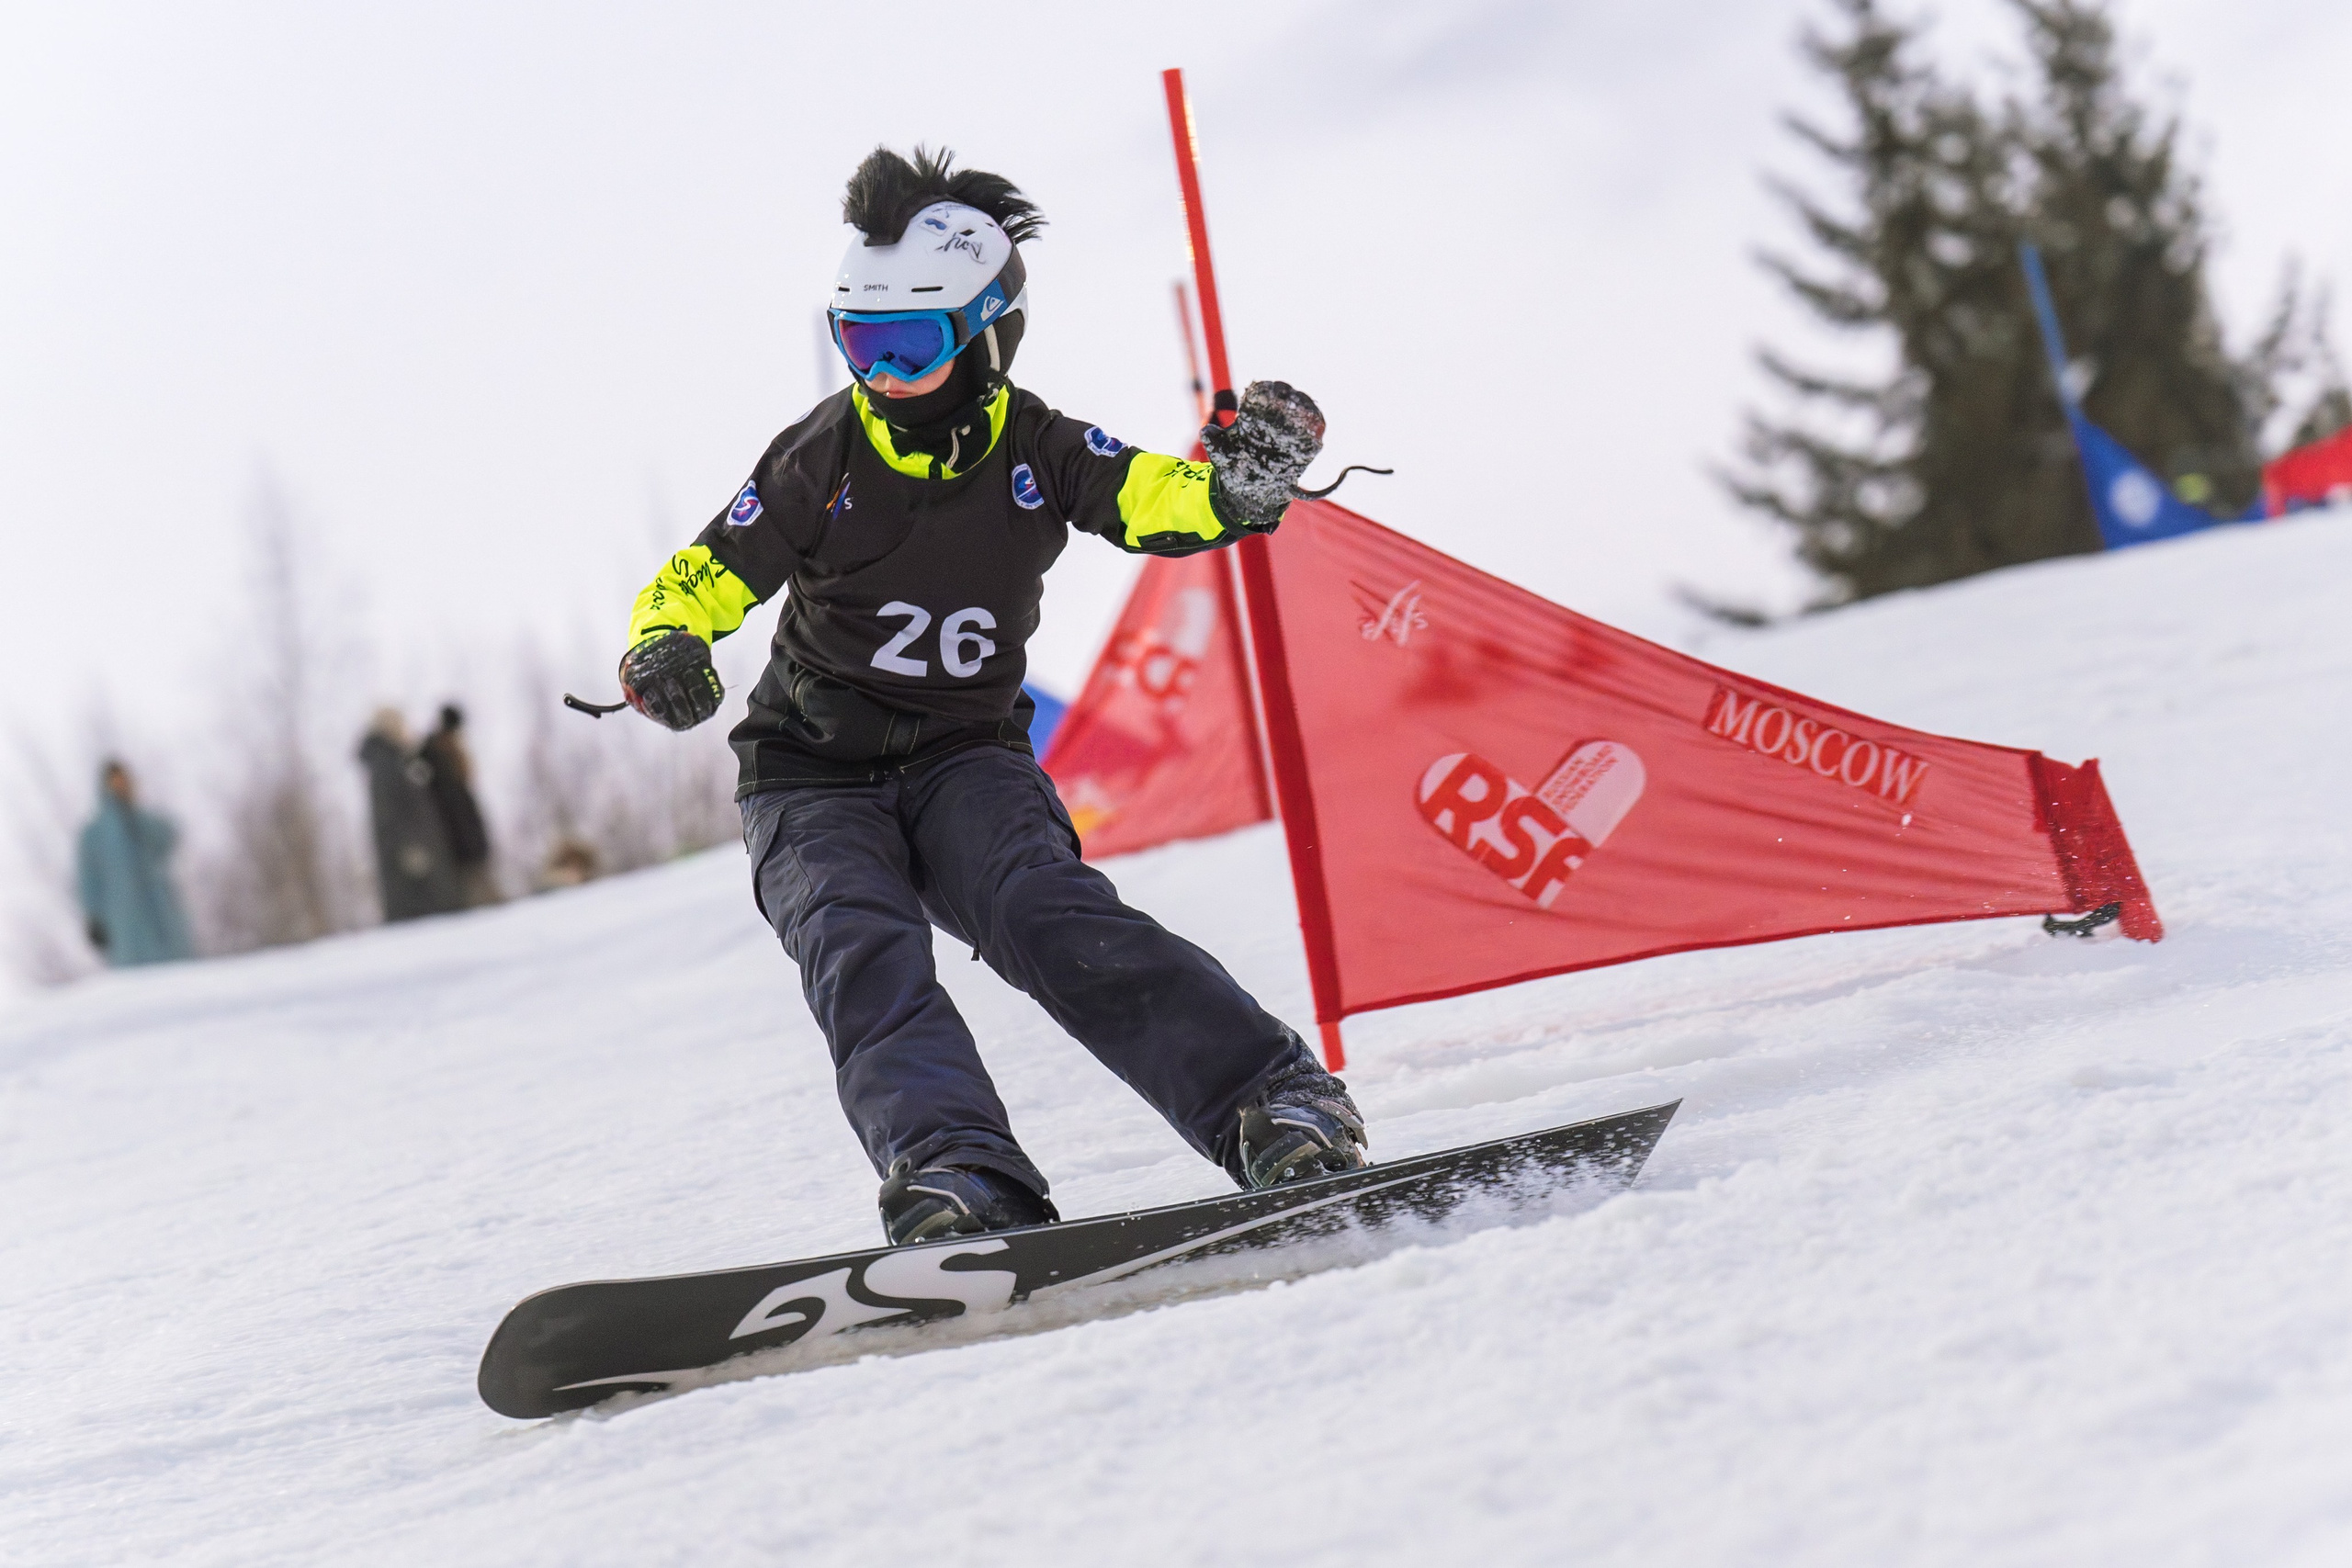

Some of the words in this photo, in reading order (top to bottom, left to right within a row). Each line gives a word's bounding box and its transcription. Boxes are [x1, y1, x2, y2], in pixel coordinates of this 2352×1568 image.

[864, 284, 888, 292] SMITH
[870, 601, 997, 678] 26
[1707, 690, 1929, 805] MOSCOW
[1421, 753, 1593, 901] RSF
